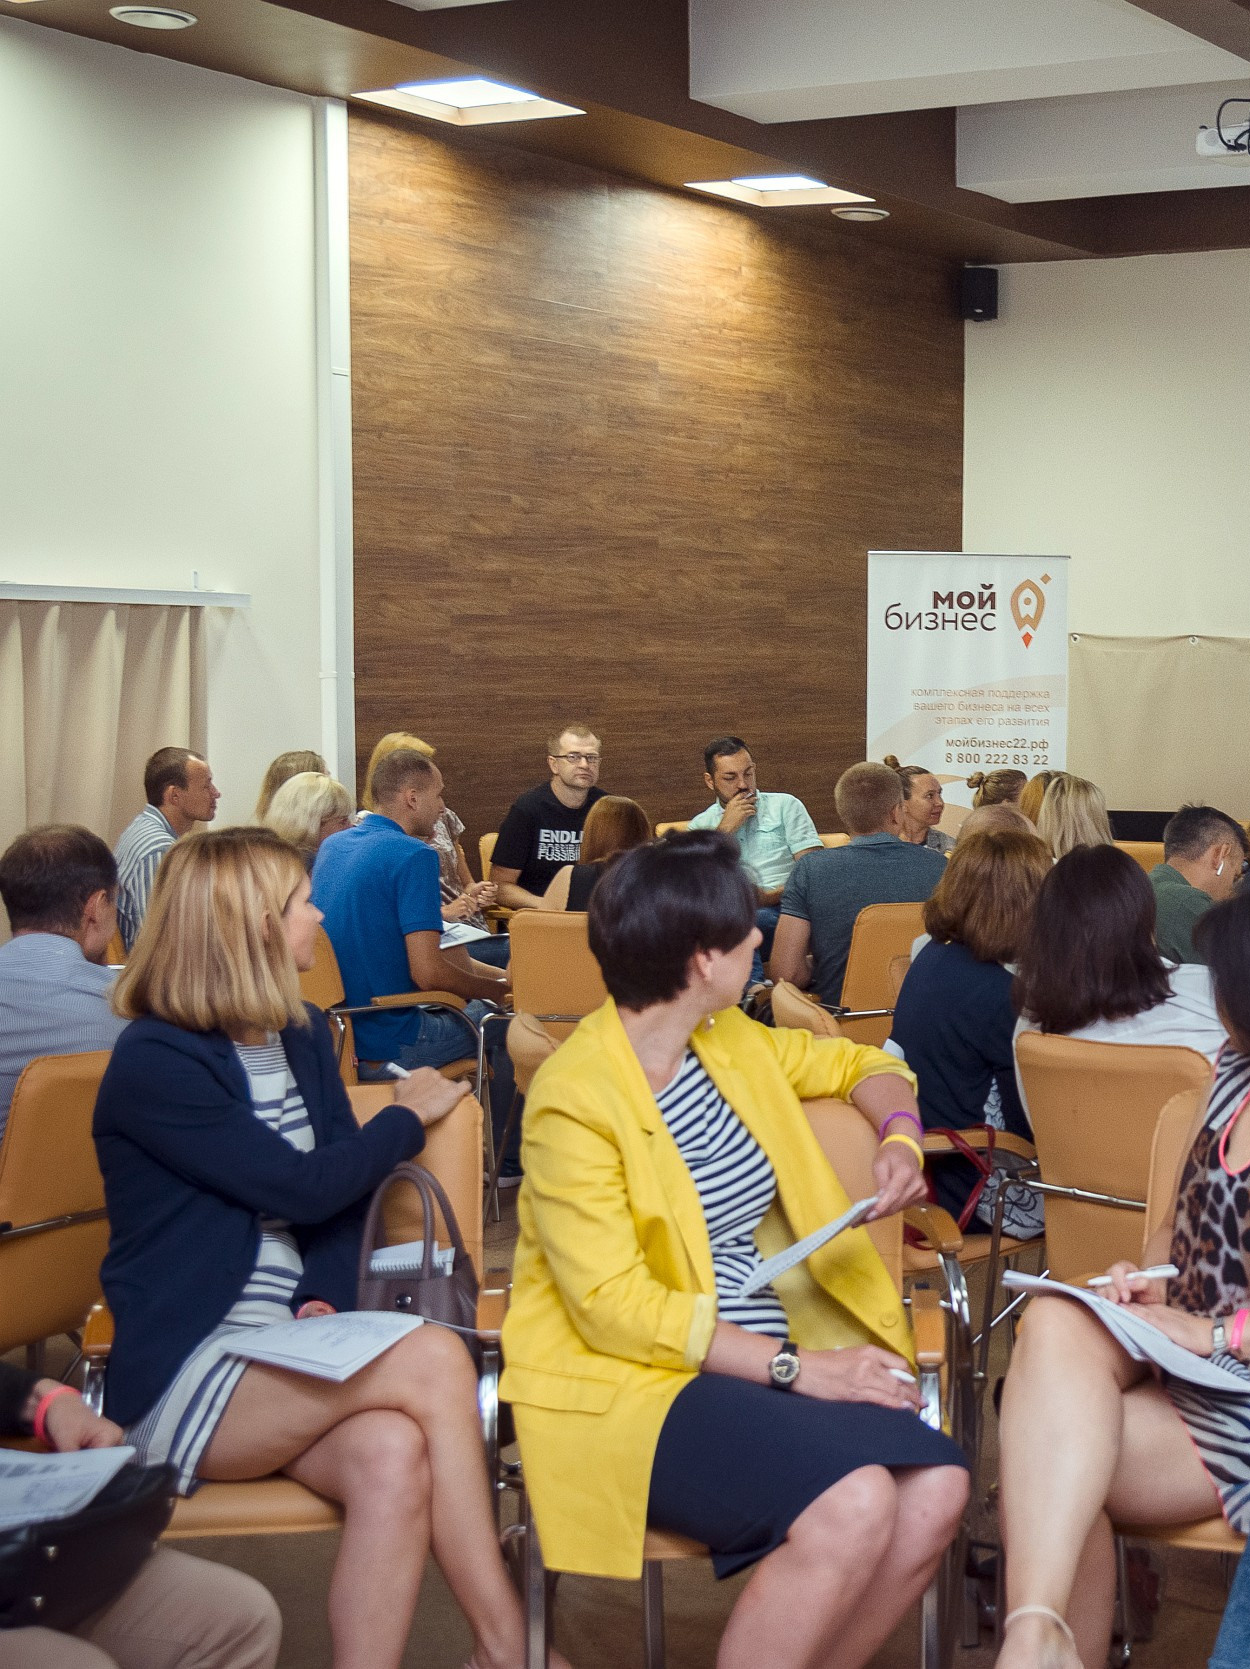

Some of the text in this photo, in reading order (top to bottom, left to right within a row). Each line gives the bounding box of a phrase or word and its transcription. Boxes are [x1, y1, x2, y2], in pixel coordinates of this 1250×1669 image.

[933, 584, 996, 610] мой
[885, 602, 997, 631] бизнес
[988, 690, 1050, 700] поддержка
[958, 701, 1003, 712] бизнеса
[1006, 703, 1022, 712] на
[1024, 704, 1049, 712] всех
[934, 716, 1049, 728] этапах его развития
[946, 737, 1049, 751] мойбизнес22.рф
[945, 753, 1048, 765] 8 800 222 83 22
